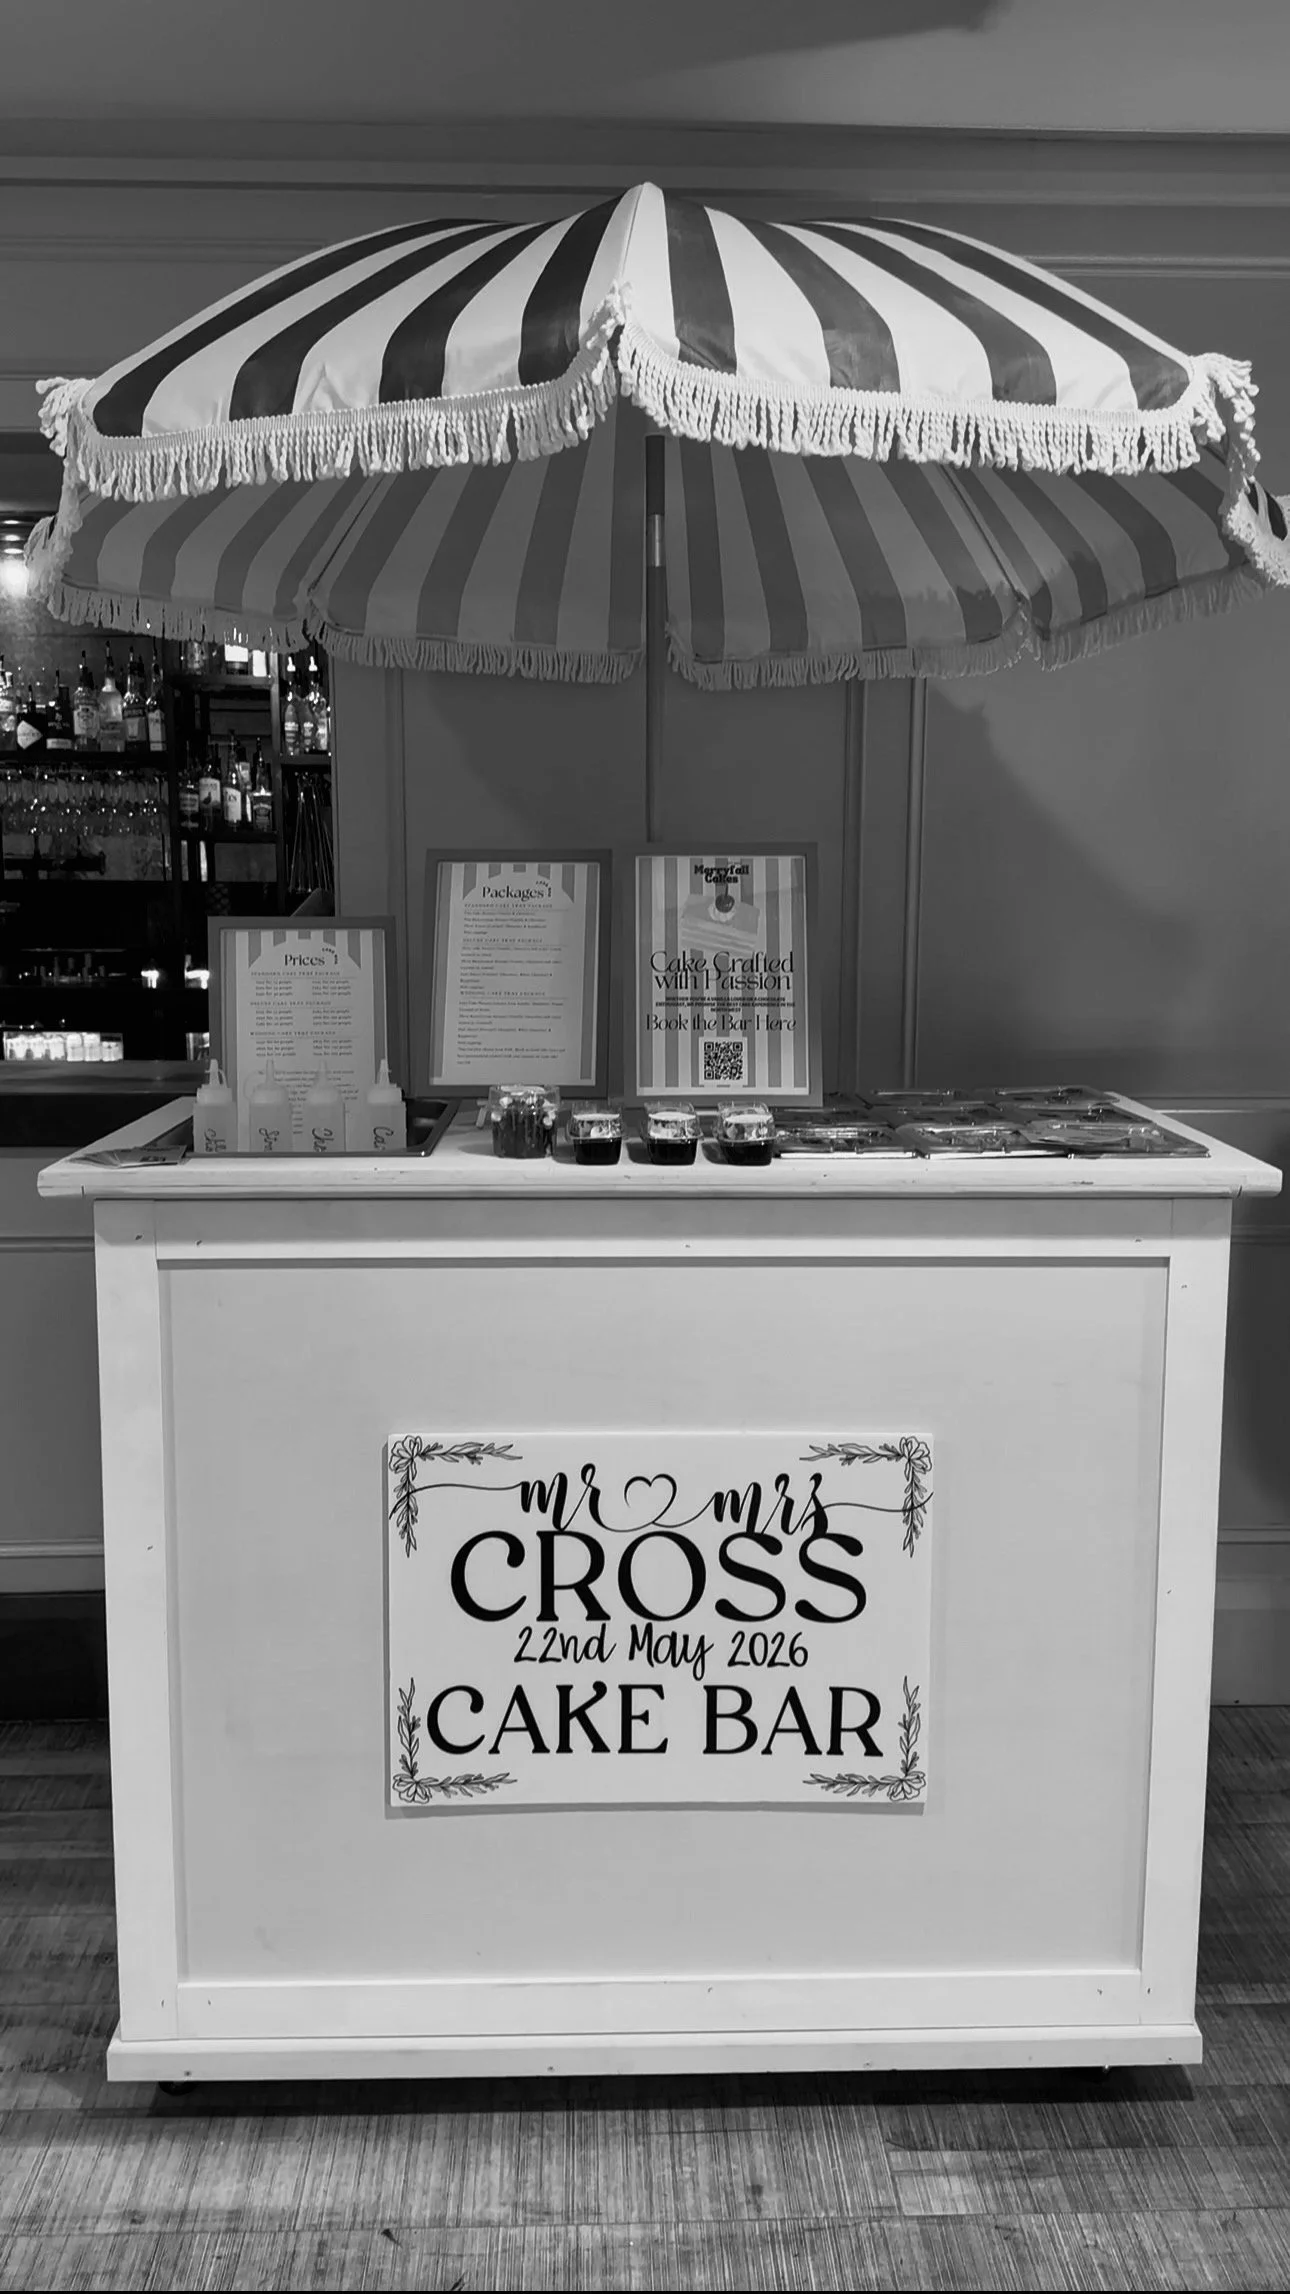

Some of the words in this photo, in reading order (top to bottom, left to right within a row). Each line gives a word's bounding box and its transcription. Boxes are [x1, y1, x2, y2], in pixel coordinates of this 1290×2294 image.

[693, 864, 750, 877] Merryfall
[704, 873, 739, 884] Cakes
[482, 885, 545, 902] Packages
[284, 954, 326, 966] Prices
[650, 950, 707, 973] Cake
[713, 950, 795, 973] Crafted
[654, 968, 698, 990] with
[705, 968, 791, 990] Passion
[646, 1013, 689, 1031] Book
[692, 1013, 718, 1031] the
[722, 1014, 752, 1031] Bar
[756, 1014, 797, 1031] Here
[519, 1463, 602, 1531] mr
[712, 1473, 829, 1535] mrs
[450, 1530, 867, 1623] CROSS
[513, 1623, 617, 1663] 22nd
[628, 1622, 714, 1681] May
[727, 1631, 809, 1668] 2026
[426, 1681, 669, 1755] CAKE
[703, 1684, 884, 1757] BAR
